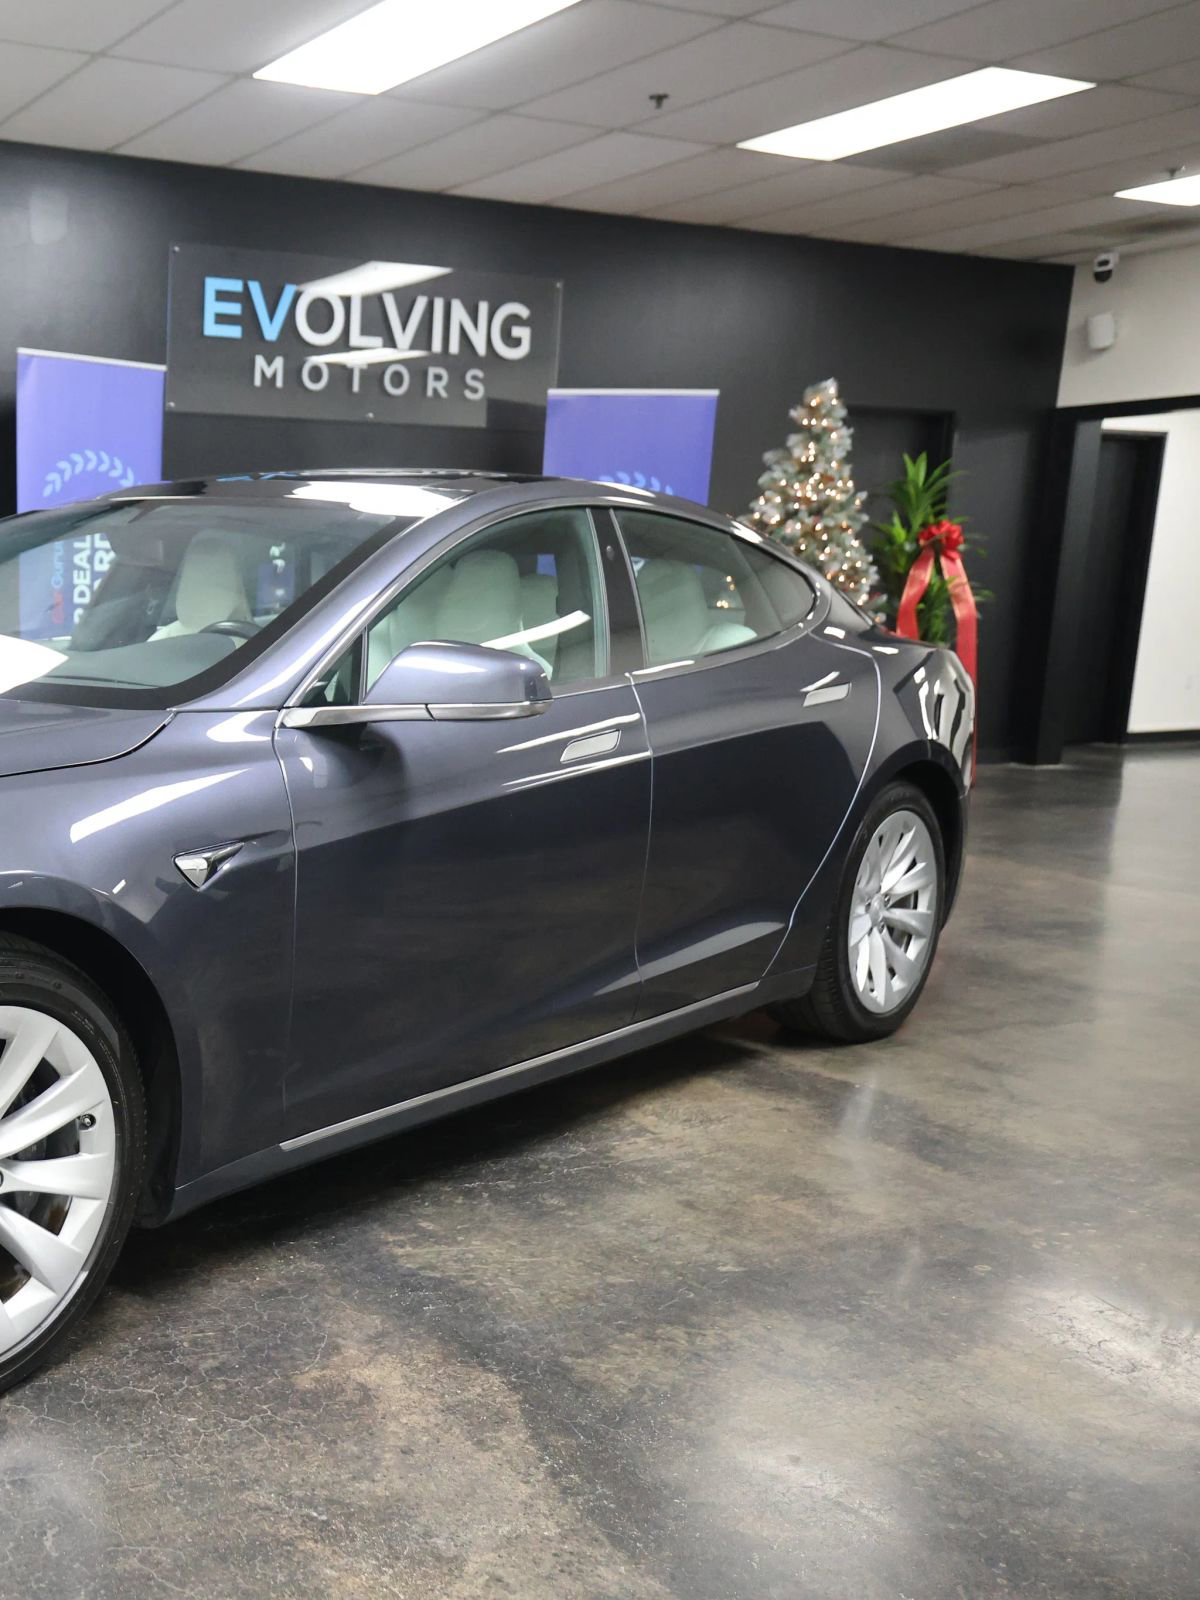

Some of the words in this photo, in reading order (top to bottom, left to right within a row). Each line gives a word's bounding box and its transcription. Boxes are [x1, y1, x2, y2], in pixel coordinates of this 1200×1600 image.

[202, 276, 532, 361] EVOLVING
[253, 353, 486, 400] MOTORS
[72, 534, 91, 605] DEAL
